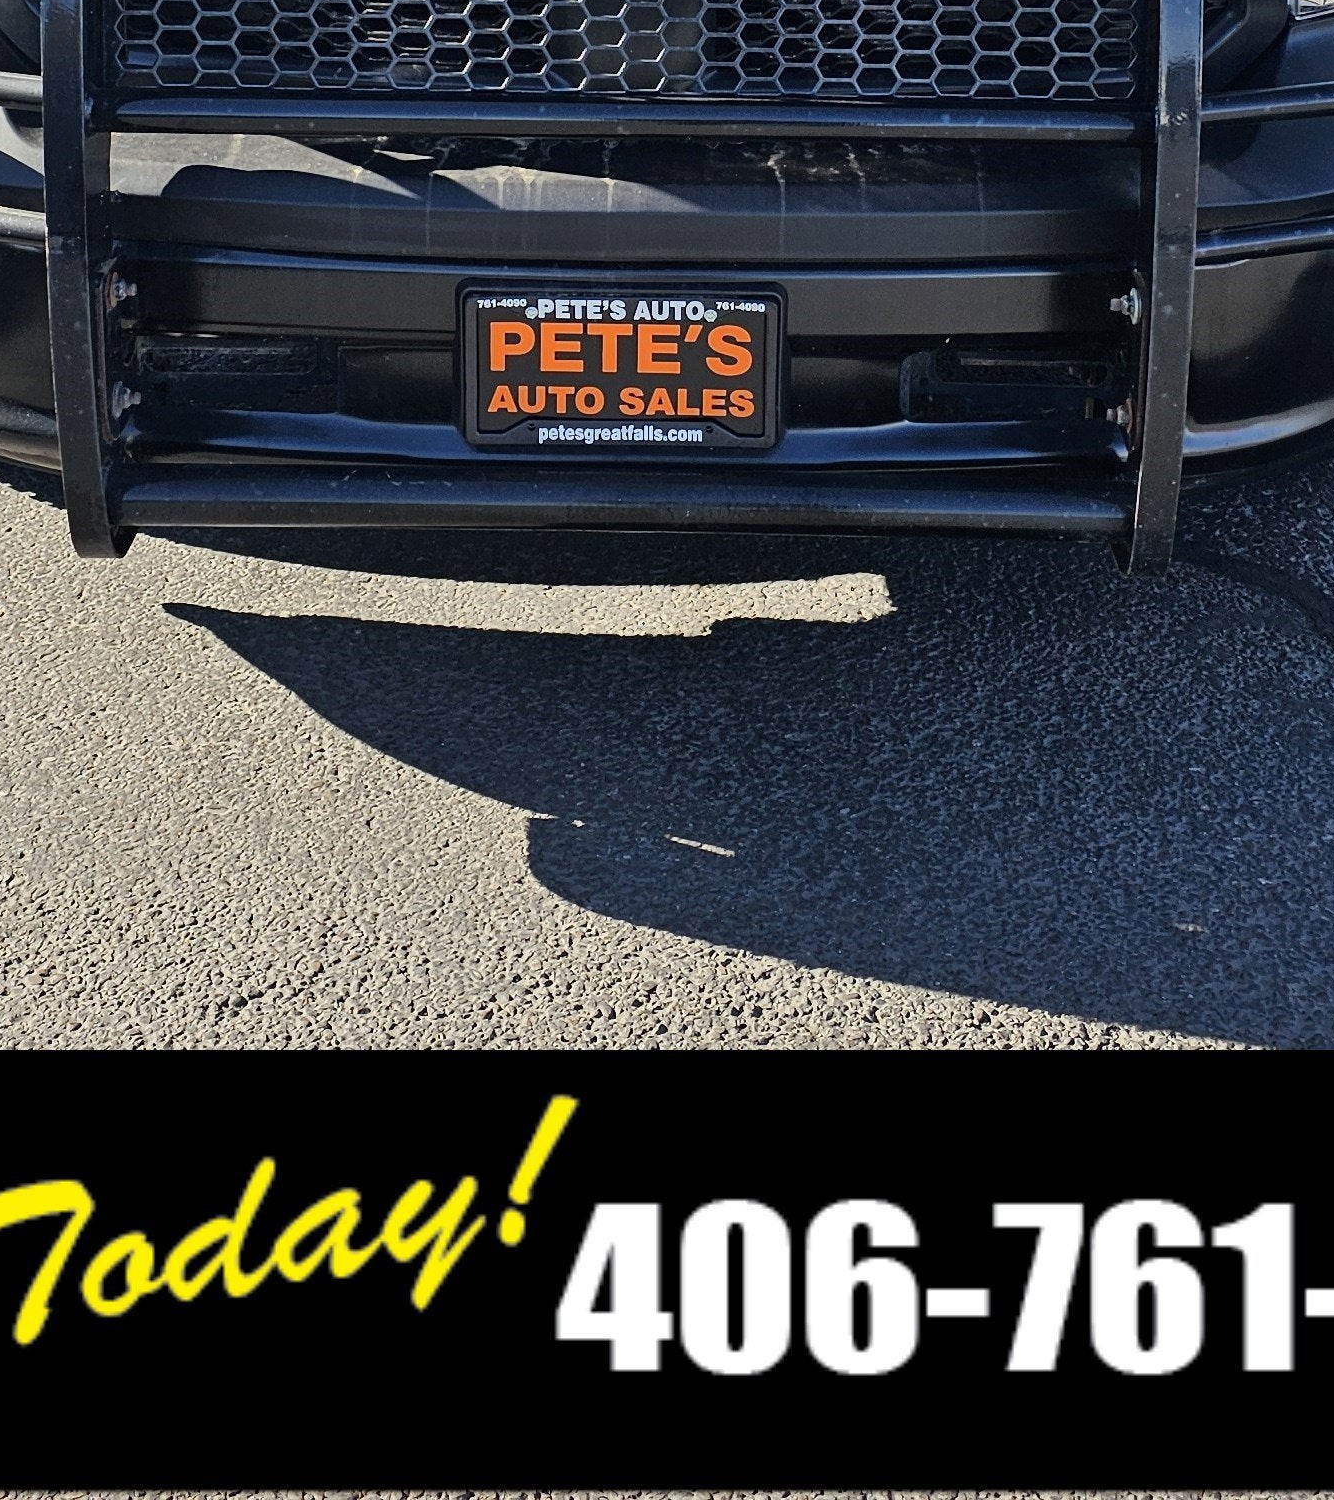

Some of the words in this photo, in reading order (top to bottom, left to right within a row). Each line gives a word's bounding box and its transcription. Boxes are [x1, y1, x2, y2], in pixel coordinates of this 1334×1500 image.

[537, 299, 627, 320] PETE'S
[633, 300, 705, 321] AUTO
[489, 321, 754, 376] PETE'S
[487, 385, 605, 415] AUTO
[619, 387, 755, 418] SALES
[538, 424, 703, 445] petesgreatfalls.com
